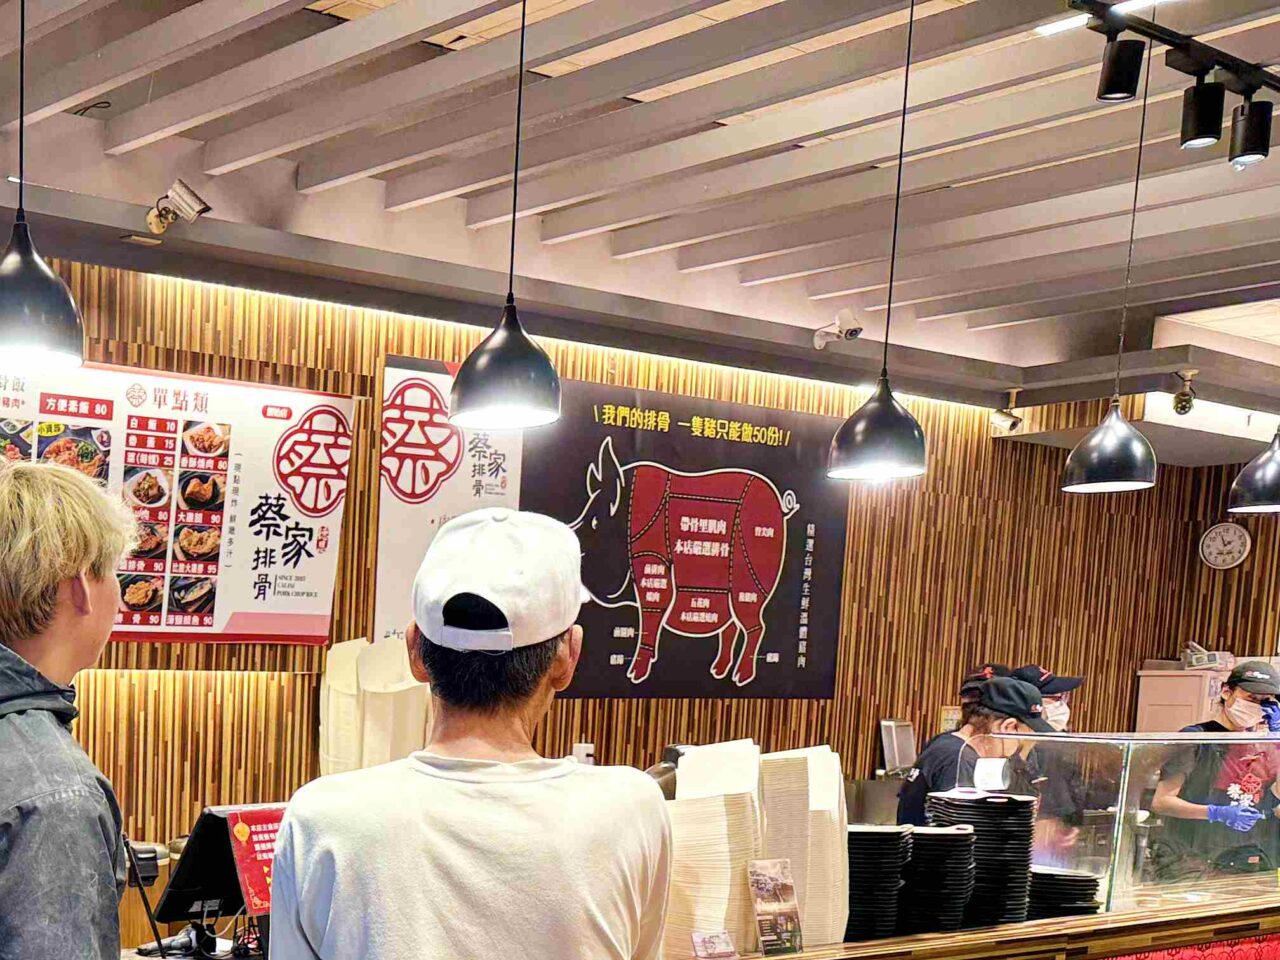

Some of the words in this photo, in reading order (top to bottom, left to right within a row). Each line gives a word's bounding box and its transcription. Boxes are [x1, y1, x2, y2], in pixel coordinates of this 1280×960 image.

[153, 388, 209, 414] 單點類
[45, 397, 90, 415] 方便素飯
[94, 403, 108, 416] 80
[602, 404, 671, 433] 我們的排骨
[166, 421, 176, 432] 10
[164, 439, 175, 450] 15
[163, 456, 174, 466] 25
[217, 460, 228, 470] 80
[158, 511, 169, 521] 80
[210, 513, 221, 524] 90
[153, 562, 164, 572] 90
[207, 564, 218, 574] 95
[149, 614, 160, 624] 90
[203, 615, 213, 625] 90
